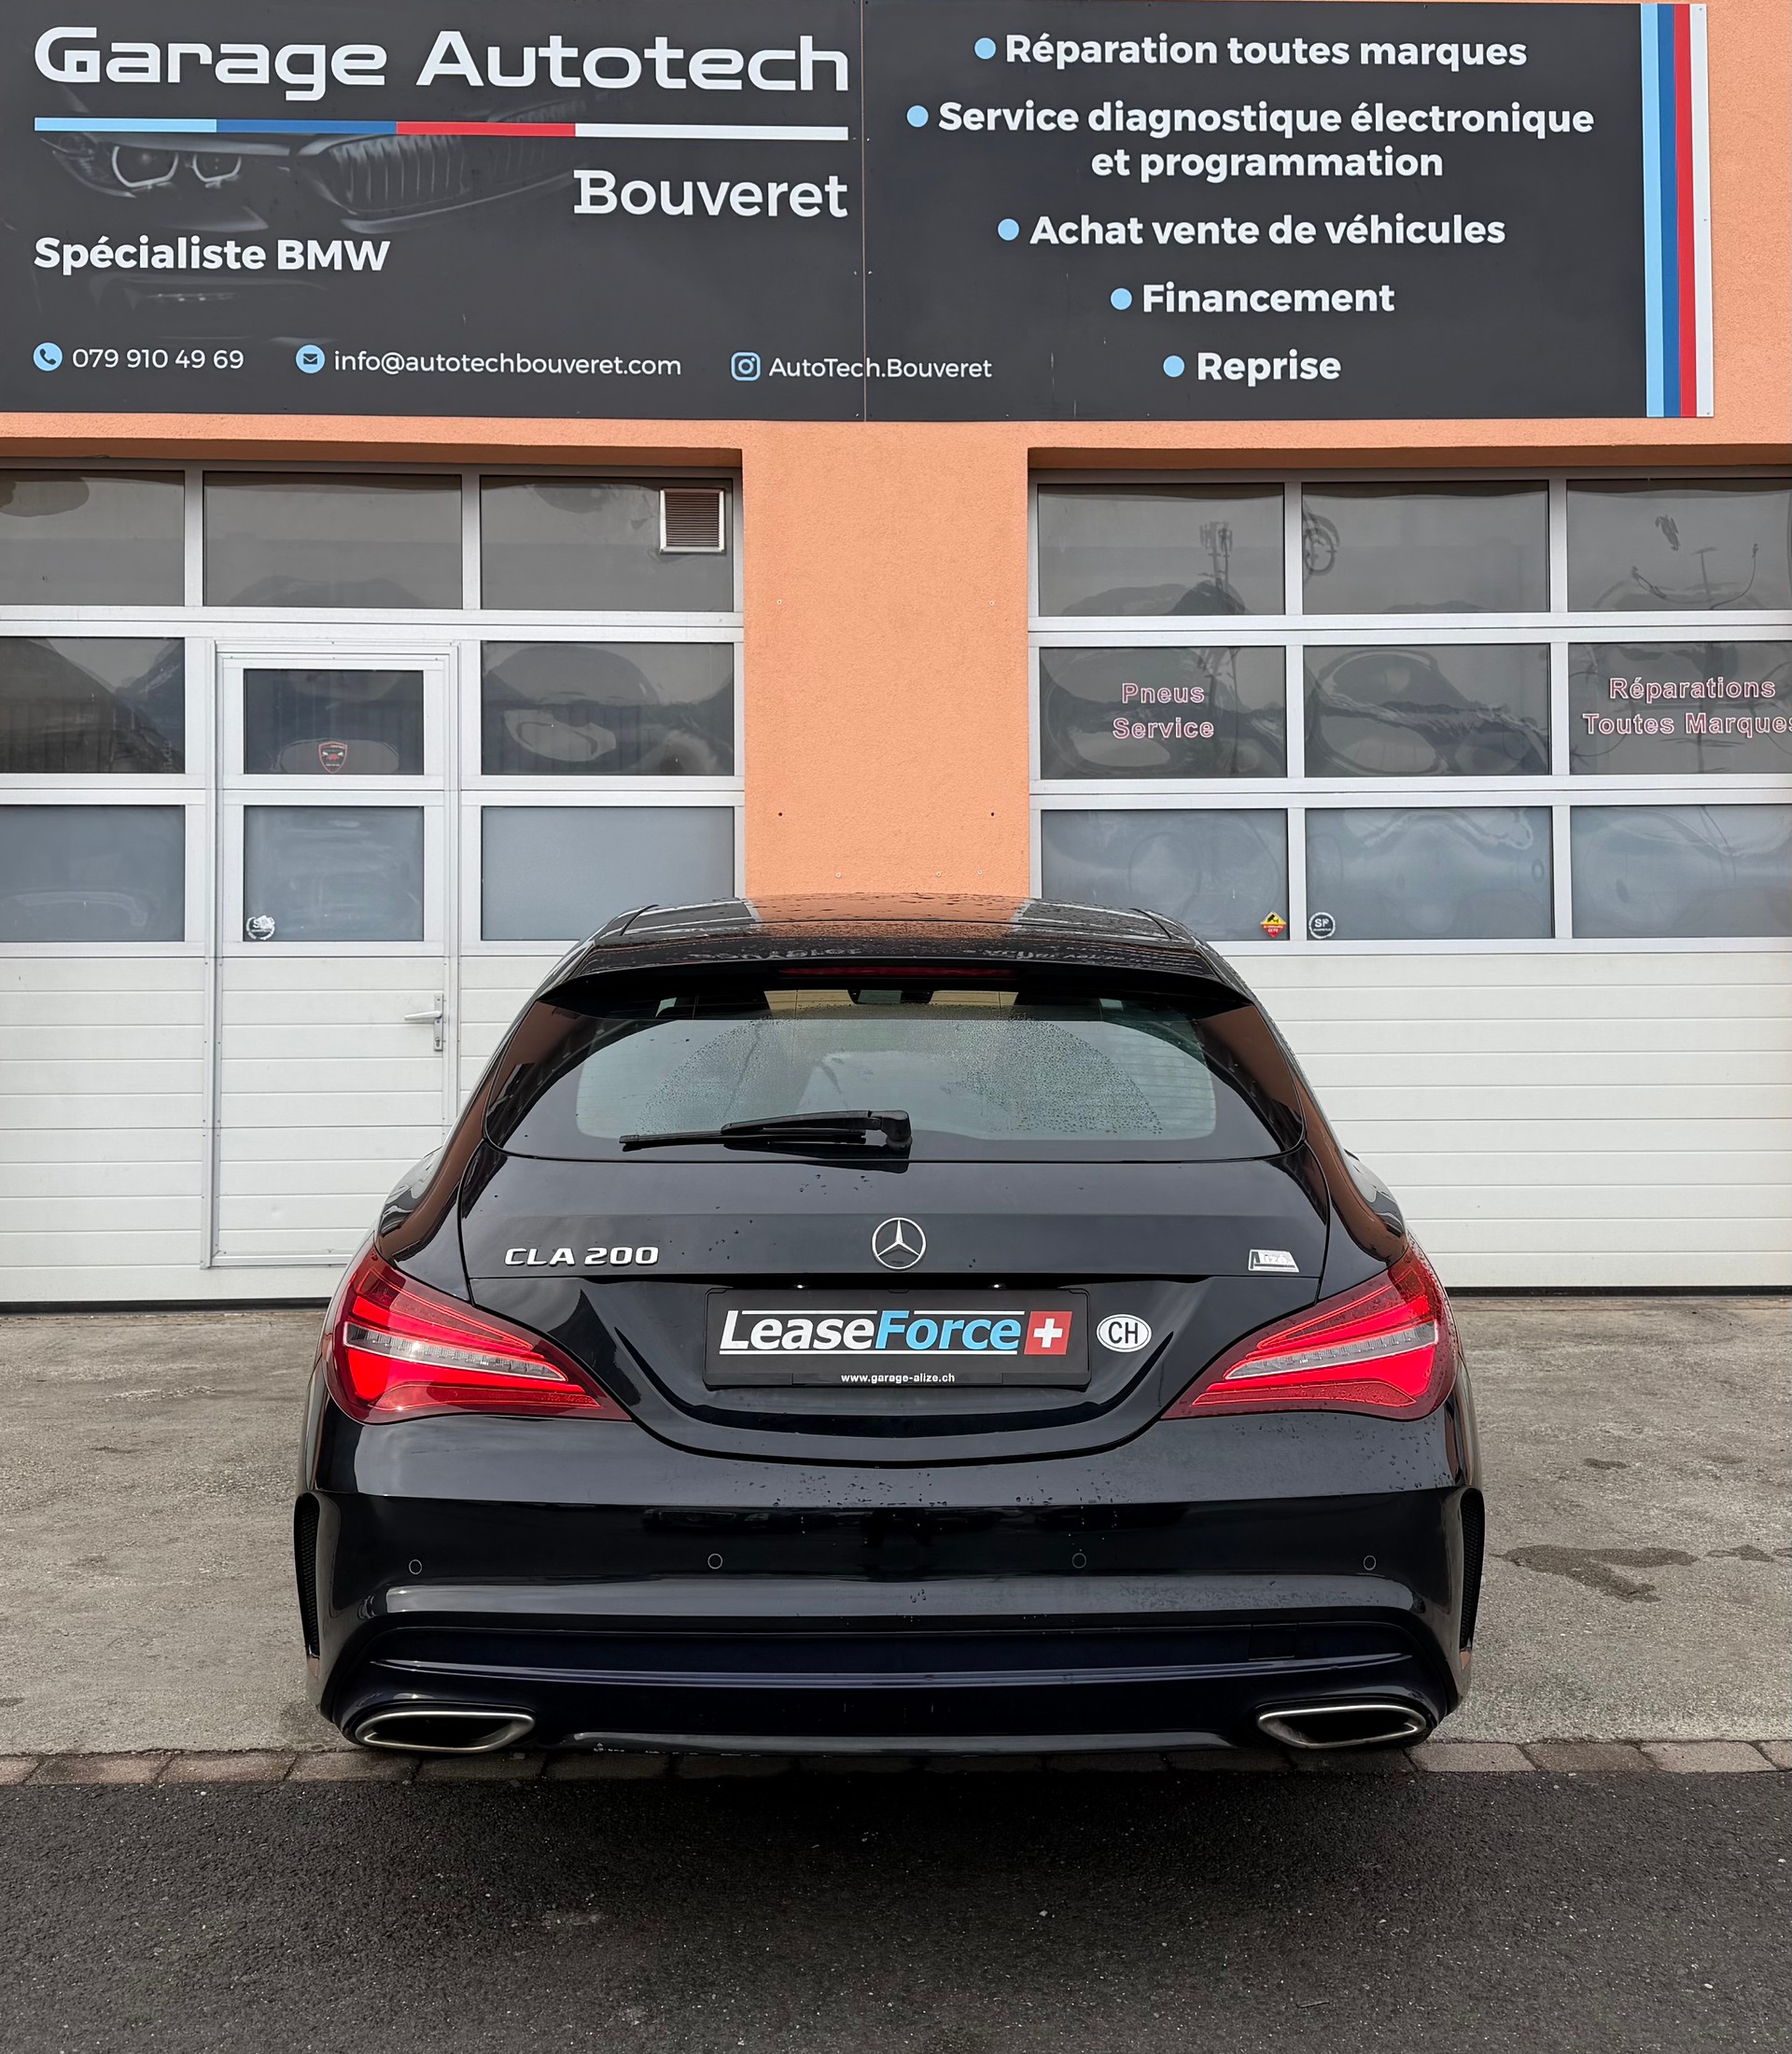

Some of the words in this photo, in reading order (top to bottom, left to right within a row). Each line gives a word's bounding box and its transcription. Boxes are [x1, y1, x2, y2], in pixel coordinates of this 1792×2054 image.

[35, 26, 386, 102] Garage
[416, 30, 848, 91] Autotech
[1006, 33, 1217, 70] Réparation
[1226, 37, 1351, 65] toutes
[1360, 41, 1527, 73] marques
[938, 100, 1080, 133] Service
[1087, 100, 1342, 139] diagnostique
[1351, 101, 1594, 140] électronique
[1091, 148, 1130, 176] et
[1141, 145, 1443, 184] programmation
[573, 169, 848, 218] Bouveret
[1029, 214, 1143, 245] Achat
[1151, 217, 1260, 245] vente
[1268, 214, 1316, 245] de
[1324, 212, 1505, 245] véhicules
[34, 234, 267, 276] Spécialiste
[277, 239, 391, 272] BMW
[1143, 281, 1395, 313] Financement
[72, 348, 119, 369] 079
[126, 348, 169, 369] 910
[175, 349, 206, 369] 49
[213, 349, 245, 370] 69
[334, 350, 681, 375] info@autotechbouveret.com
[768, 357, 993, 379] AutoTech.Bouveret
[1197, 349, 1341, 387] Reprise
[1122, 682, 1205, 704] Pneus
[1609, 677, 1776, 705] Réparations
[1112, 717, 1214, 739] Service
[1582, 713, 1675, 735] Toutes
[504, 1248, 575, 1266] CLA
[584, 1246, 659, 1265] 200
[719, 1309, 1021, 1349] LeaseForce
[1108, 1320, 1139, 1345] CH
[840, 1372, 956, 1384] www.garage-alize.ch
